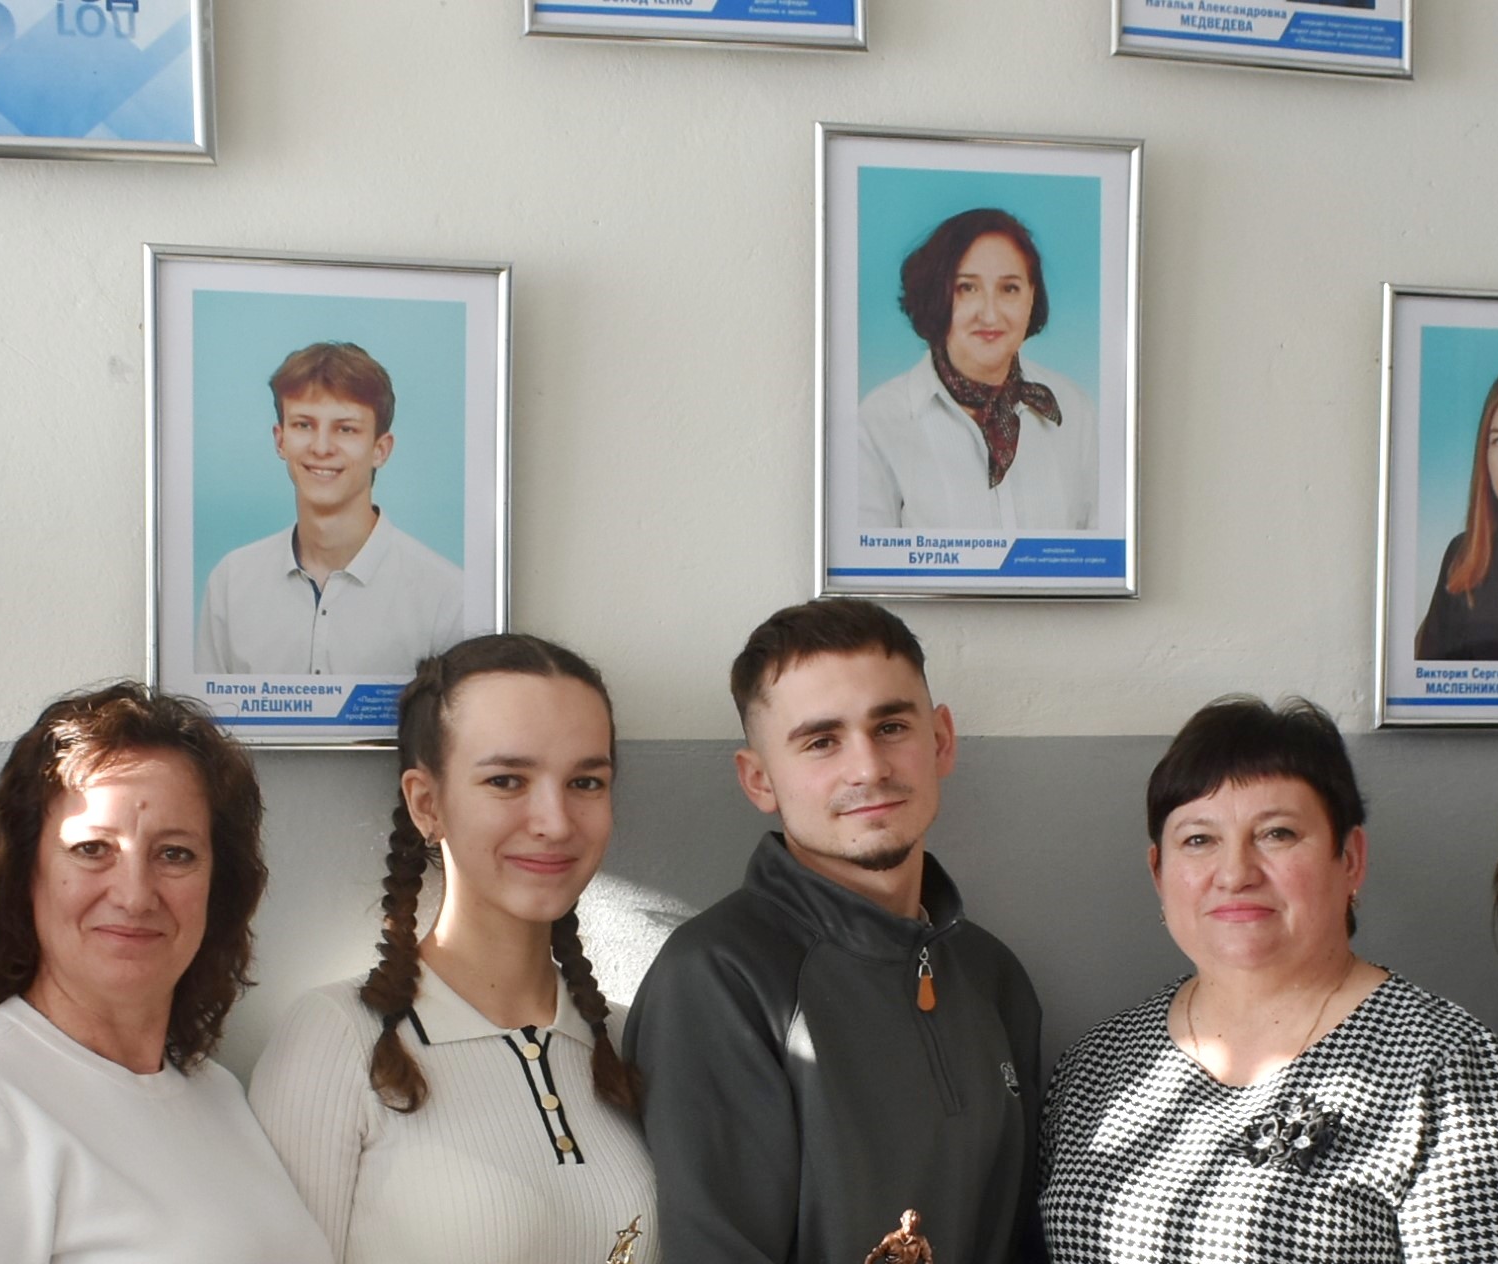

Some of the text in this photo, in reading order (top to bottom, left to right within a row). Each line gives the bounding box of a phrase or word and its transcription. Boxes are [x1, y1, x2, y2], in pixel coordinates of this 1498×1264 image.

[1198, 2, 1287, 19] Александровна
[1181, 14, 1253, 32] МЕДВЕДЕВА
[860, 535, 1008, 549] Наталия Владимировна
[909, 552, 959, 564] БУРЛАК
[1416, 667, 1468, 680] Виктория
[206, 681, 342, 695] Платон Алексеевич
[241, 696, 313, 712] АЛЁШКИН
